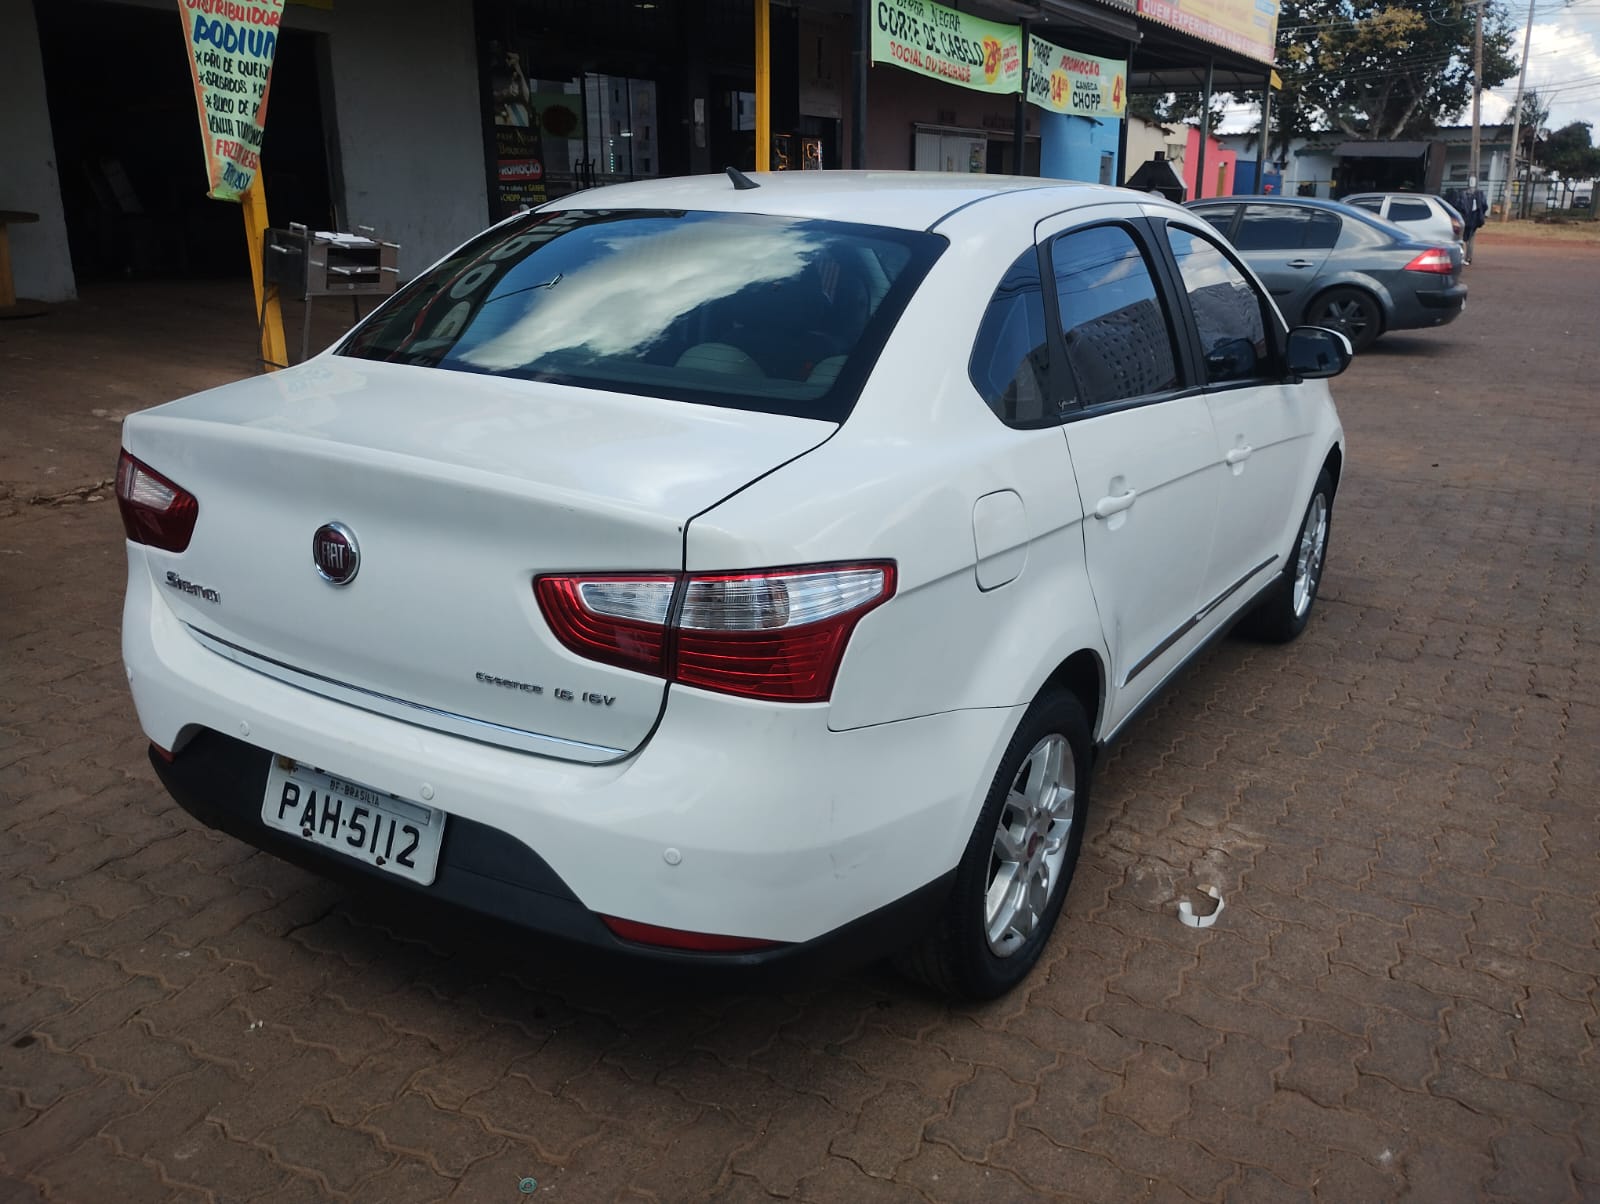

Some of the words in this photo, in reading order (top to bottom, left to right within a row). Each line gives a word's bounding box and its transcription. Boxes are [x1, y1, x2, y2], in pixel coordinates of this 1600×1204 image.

[930, 4, 962, 33] NEGRA
[878, 2, 921, 46] CORTE
[923, 23, 941, 54] DE
[941, 31, 984, 67] CABELO
[204, 49, 221, 69] PÃO
[223, 57, 233, 74] DE
[238, 60, 271, 80] QUEIJ
[890, 41, 922, 68] SOCIAL
[925, 55, 936, 73] OU
[938, 58, 971, 83] DEGRADÉ
[1060, 55, 1100, 78] PROMOÇÃO
[206, 70, 247, 93] SALGADOS
[1075, 80, 1097, 91] CANECA
[238, 99, 249, 116] DE
[1072, 91, 1100, 110] CHOPP
[321, 540, 345, 569] FIAT
[475, 671, 544, 694] Essence
[582, 691, 616, 706] 16V
